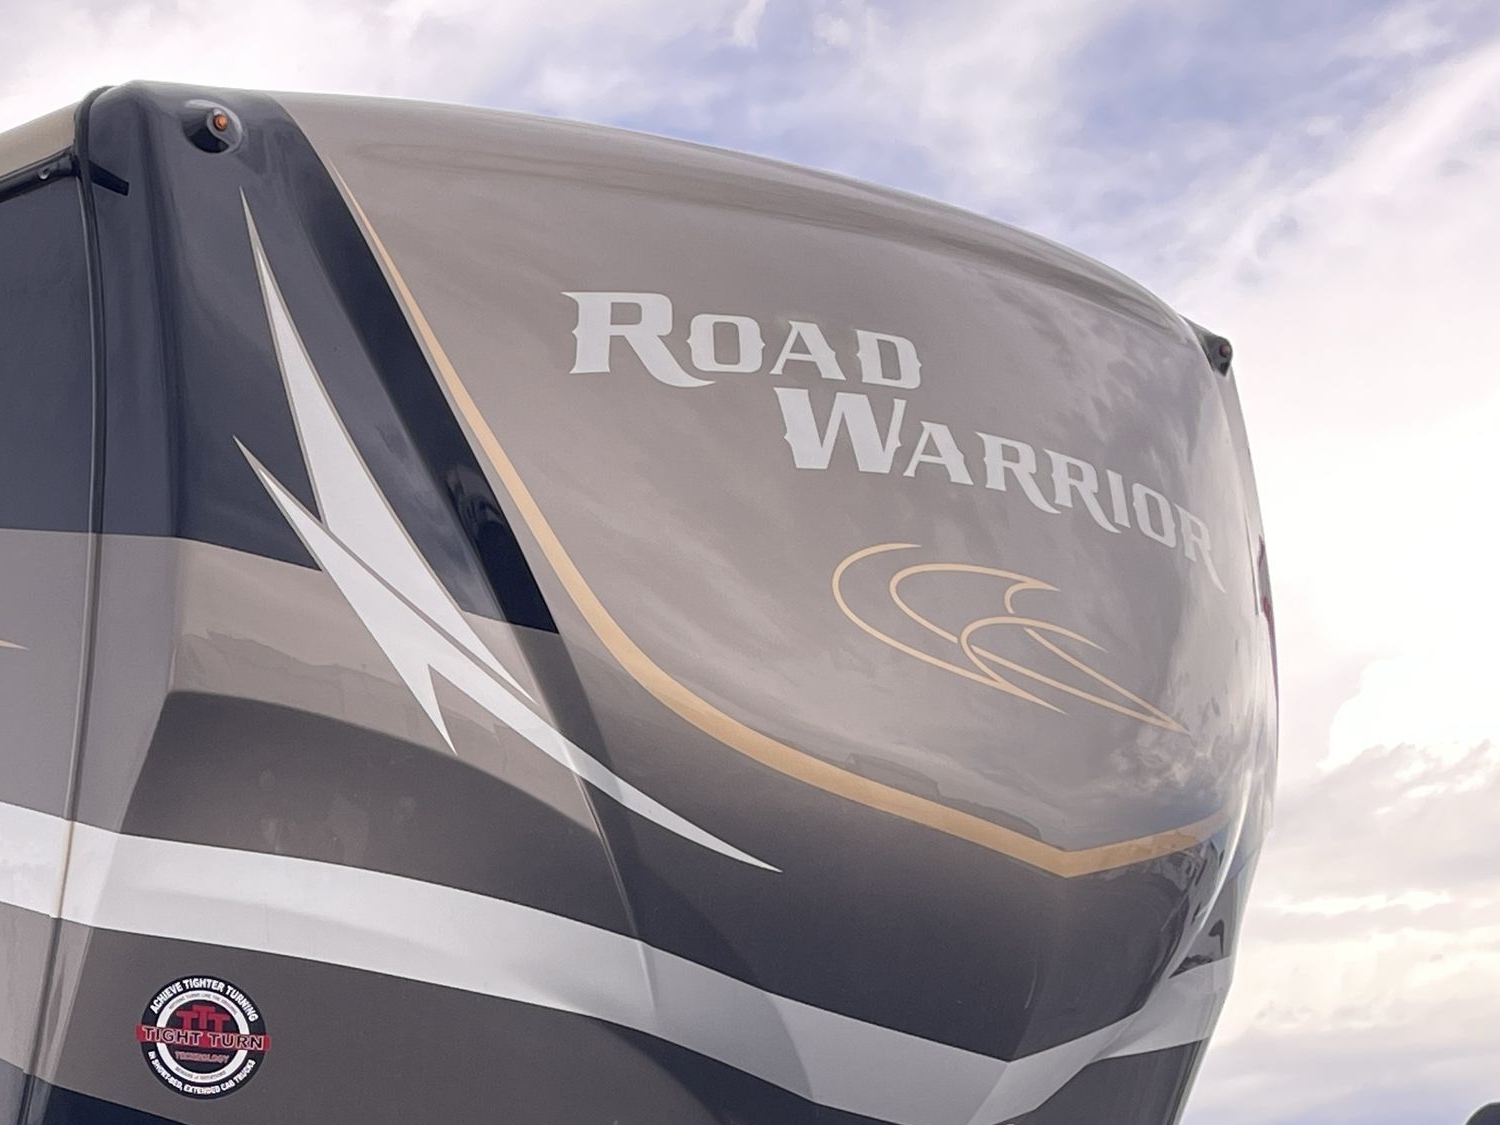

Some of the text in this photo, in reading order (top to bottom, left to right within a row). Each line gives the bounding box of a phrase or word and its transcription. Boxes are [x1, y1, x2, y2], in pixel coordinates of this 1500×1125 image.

[561, 291, 923, 388] ROAD
[774, 387, 1225, 594] WARRIOR
[150, 982, 183, 1014] ACHIEVE
[183, 978, 224, 993] TIGHTER
[226, 985, 259, 1022] TURNING
[142, 1026, 264, 1050] TIGHT TURN
